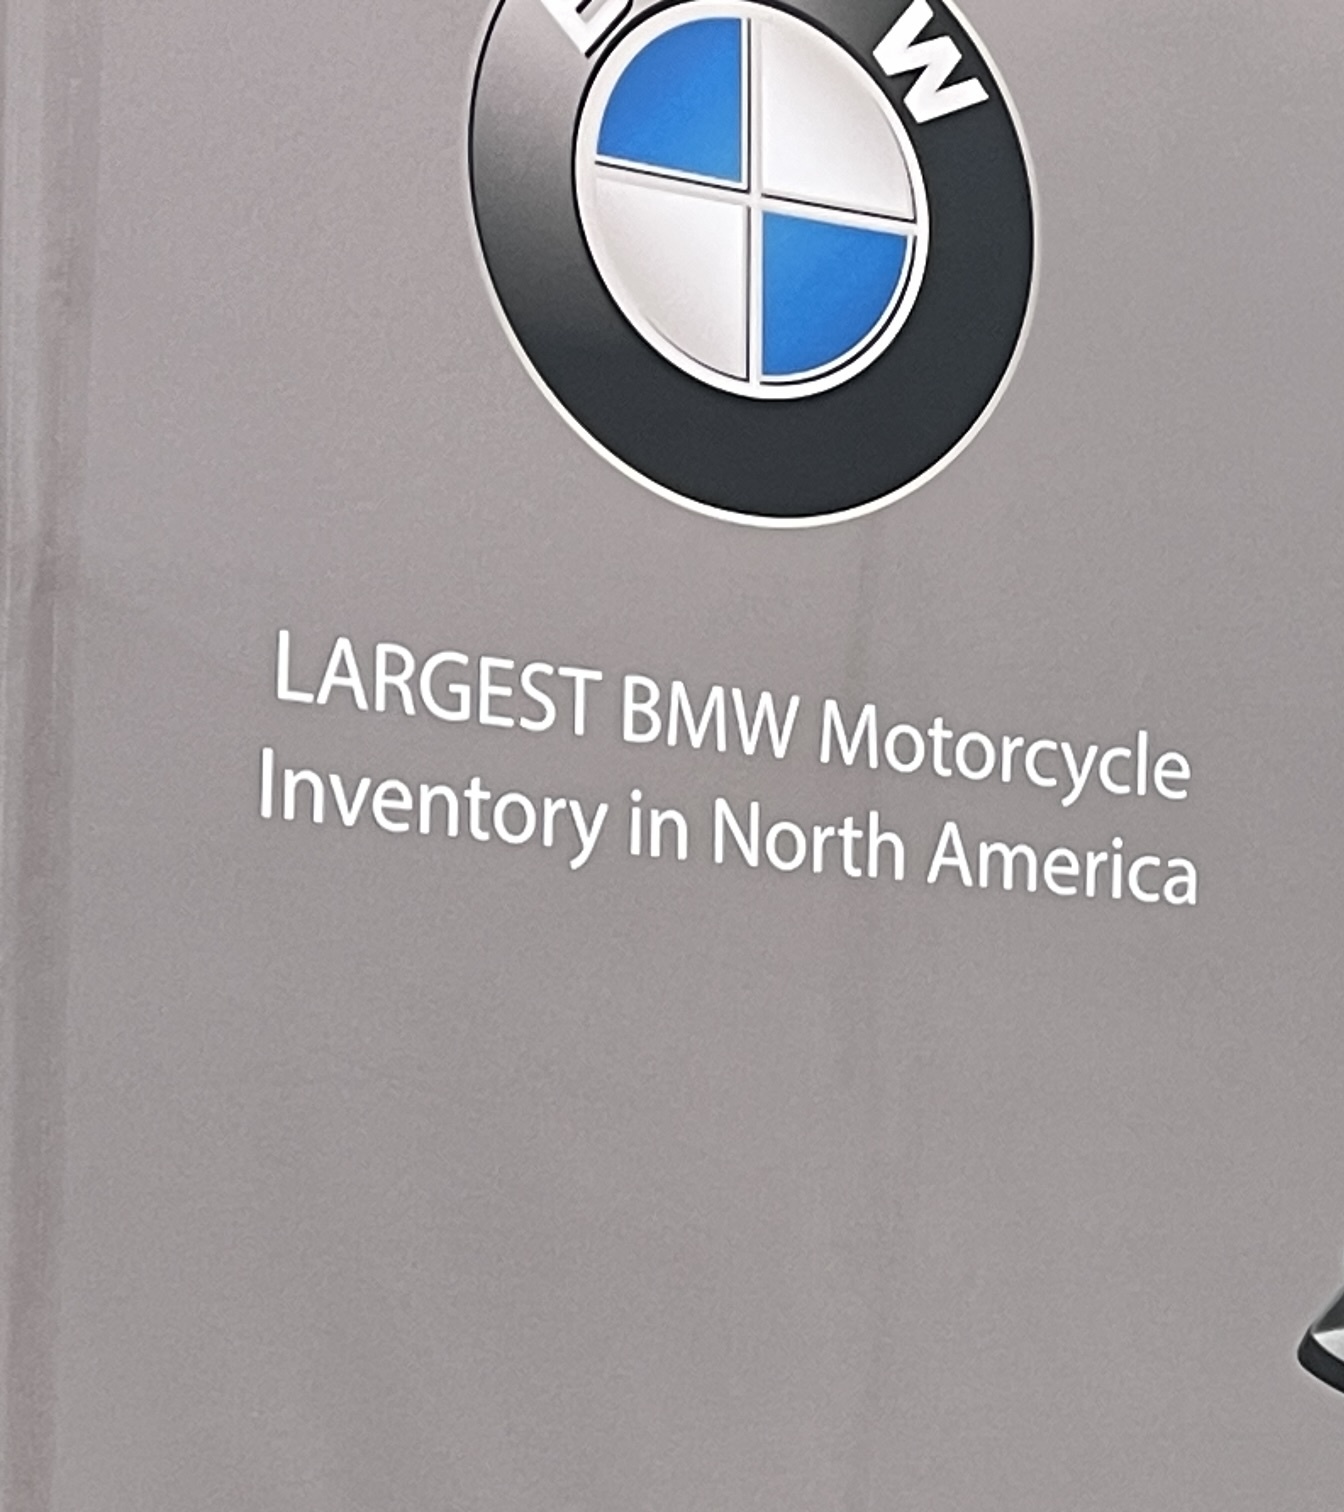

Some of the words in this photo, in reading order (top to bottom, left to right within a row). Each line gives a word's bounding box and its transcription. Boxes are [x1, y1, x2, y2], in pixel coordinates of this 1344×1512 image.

[276, 628, 604, 737] LARGEST
[622, 674, 801, 760] BMW
[819, 698, 1192, 808] Motorcycle
[260, 746, 610, 871] Inventory
[629, 788, 689, 861] in
[713, 796, 906, 882] North
[926, 820, 1198, 906] America
